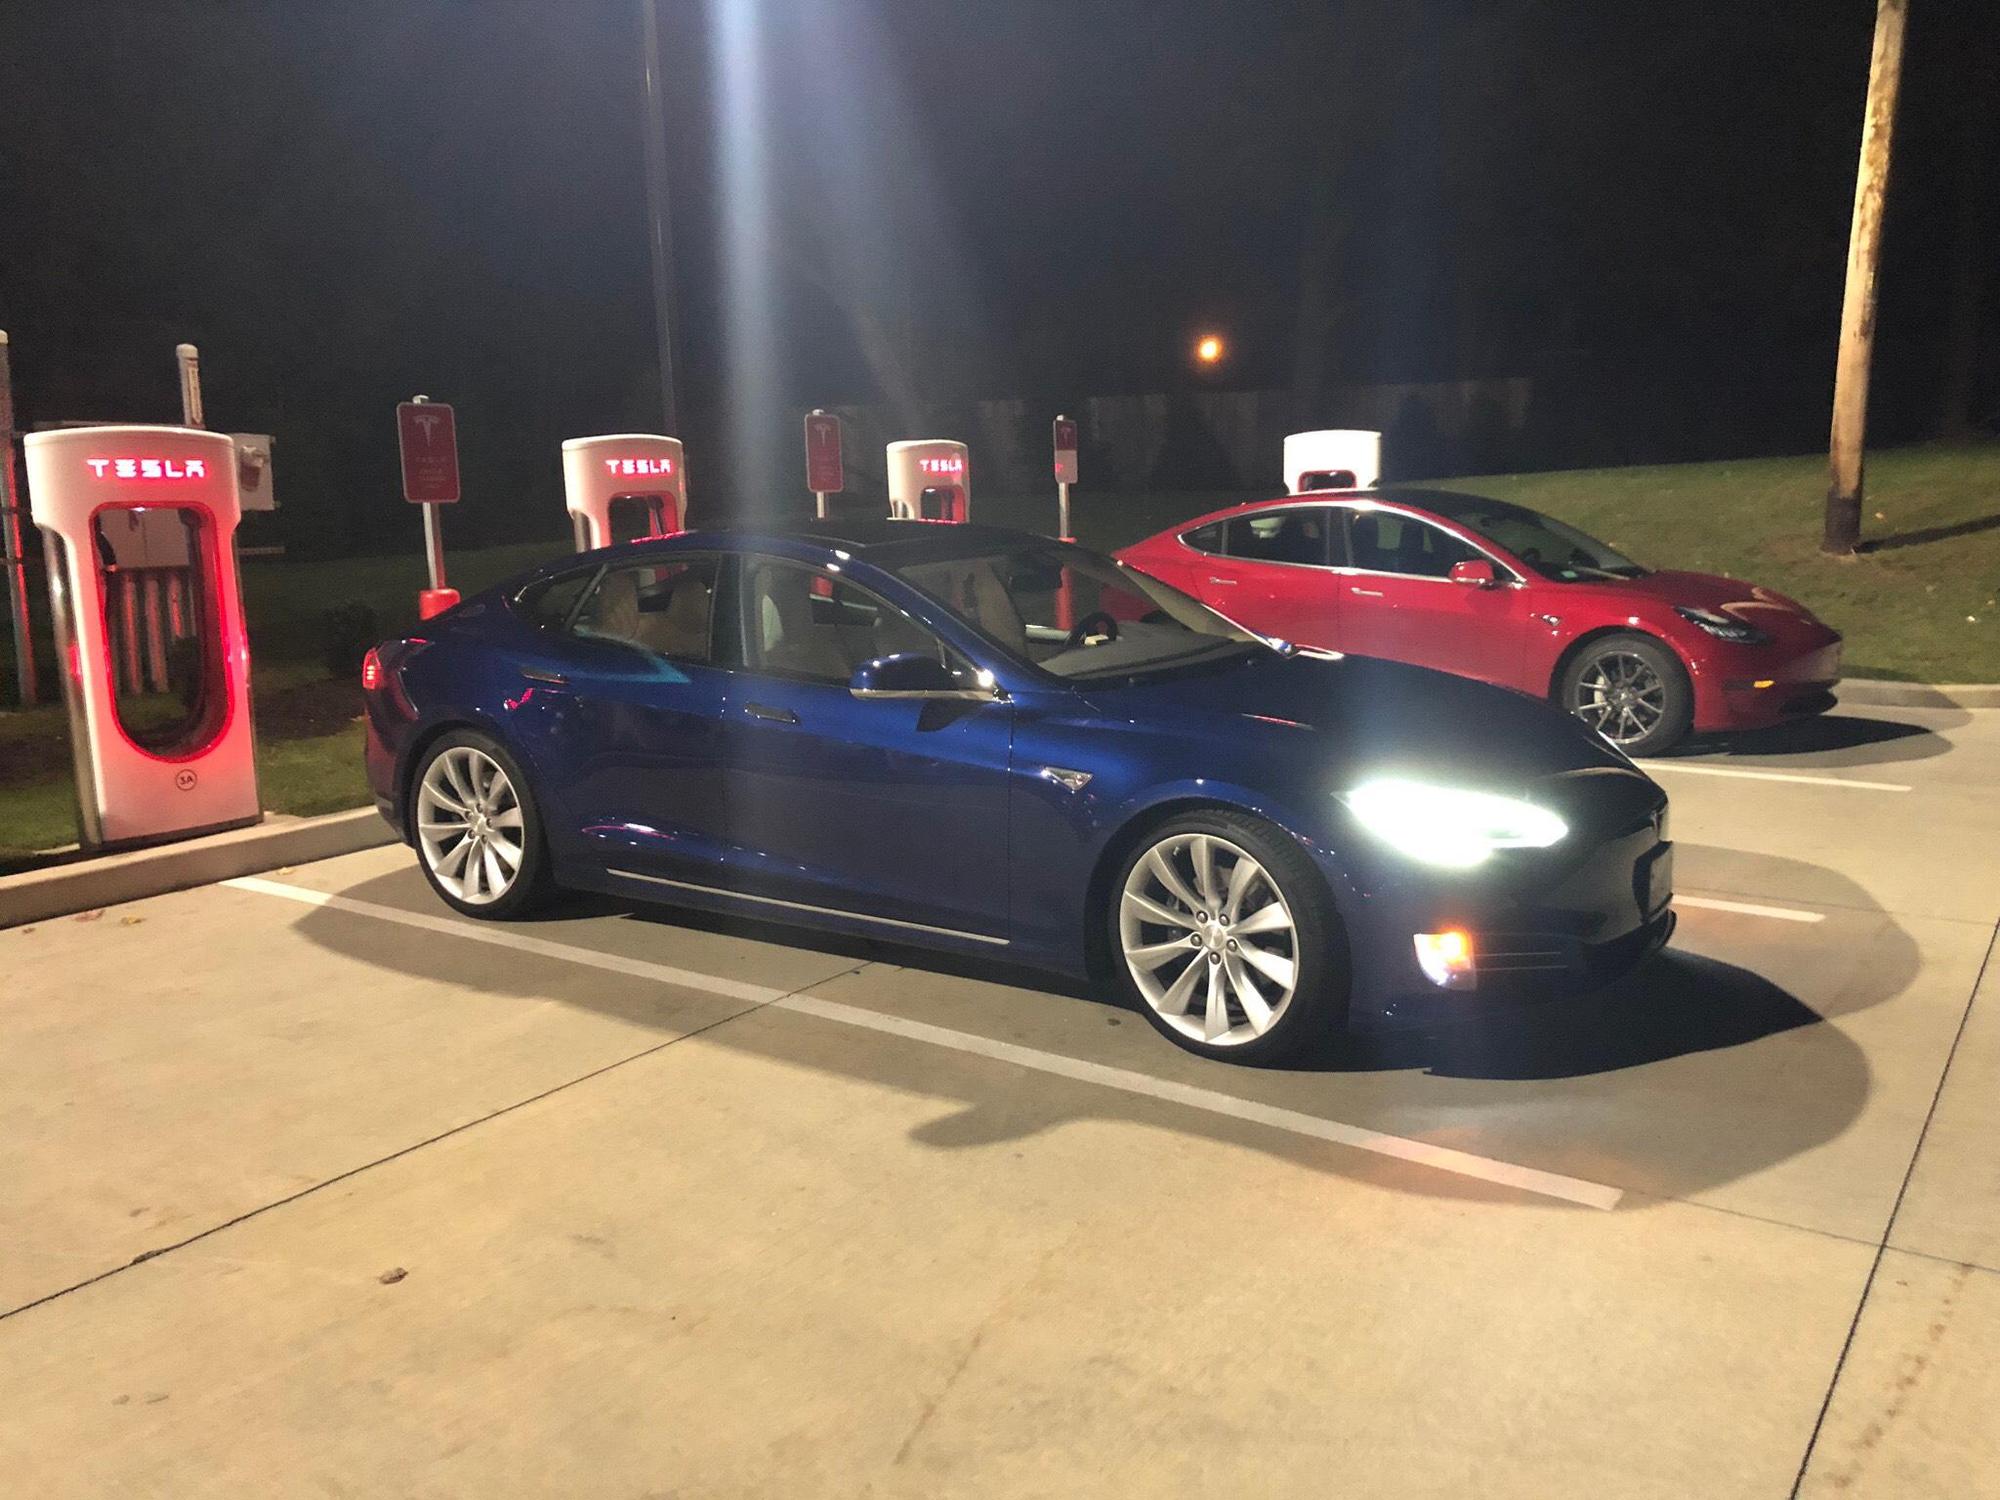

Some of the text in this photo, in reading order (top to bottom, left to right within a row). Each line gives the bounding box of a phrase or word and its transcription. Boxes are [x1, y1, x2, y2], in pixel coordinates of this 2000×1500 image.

[86, 458, 205, 478] TESLA
[605, 458, 671, 474] TESLA
[919, 459, 963, 472] TESLA
